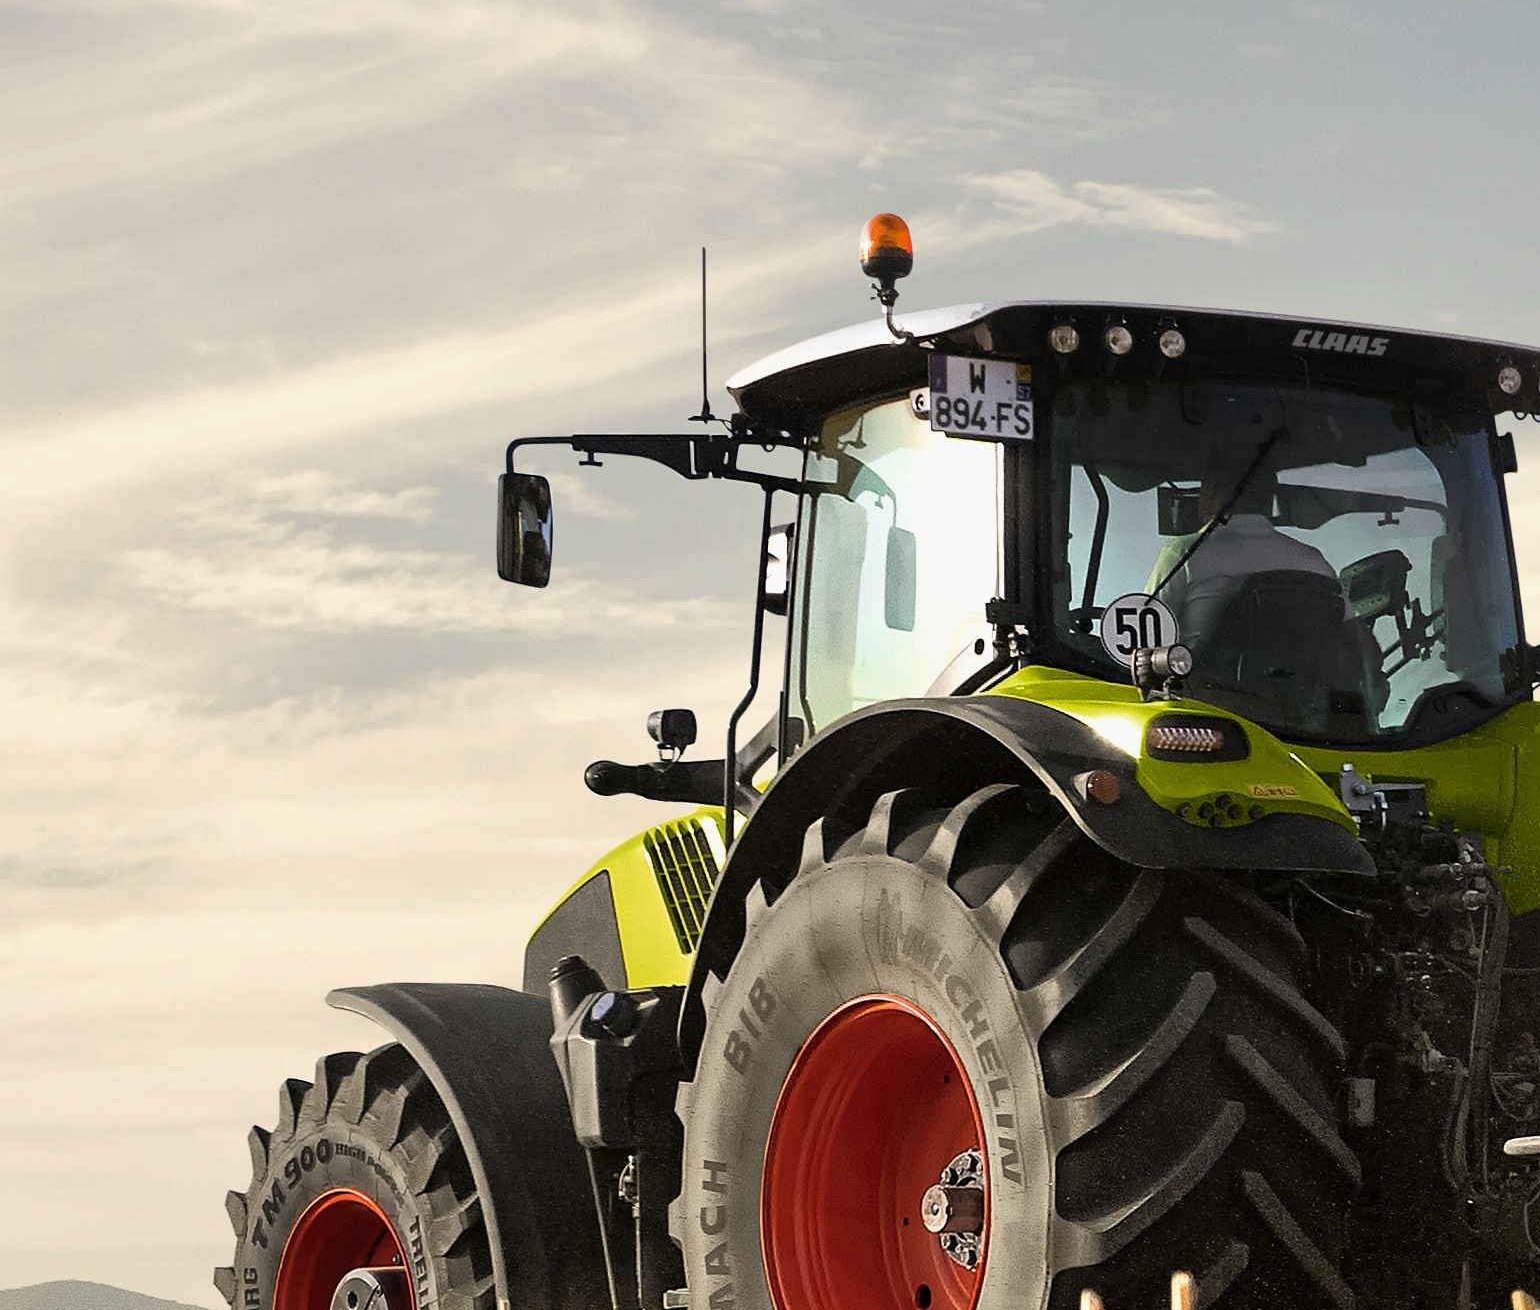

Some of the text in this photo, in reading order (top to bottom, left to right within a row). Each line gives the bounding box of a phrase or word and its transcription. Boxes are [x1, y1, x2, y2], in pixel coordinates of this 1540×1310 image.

[1291, 329, 1390, 357] CLAAS
[969, 362, 986, 395] W
[1115, 607, 1162, 655] 50
[723, 976, 777, 1075] BIB
[283, 1137, 333, 1190] 900
